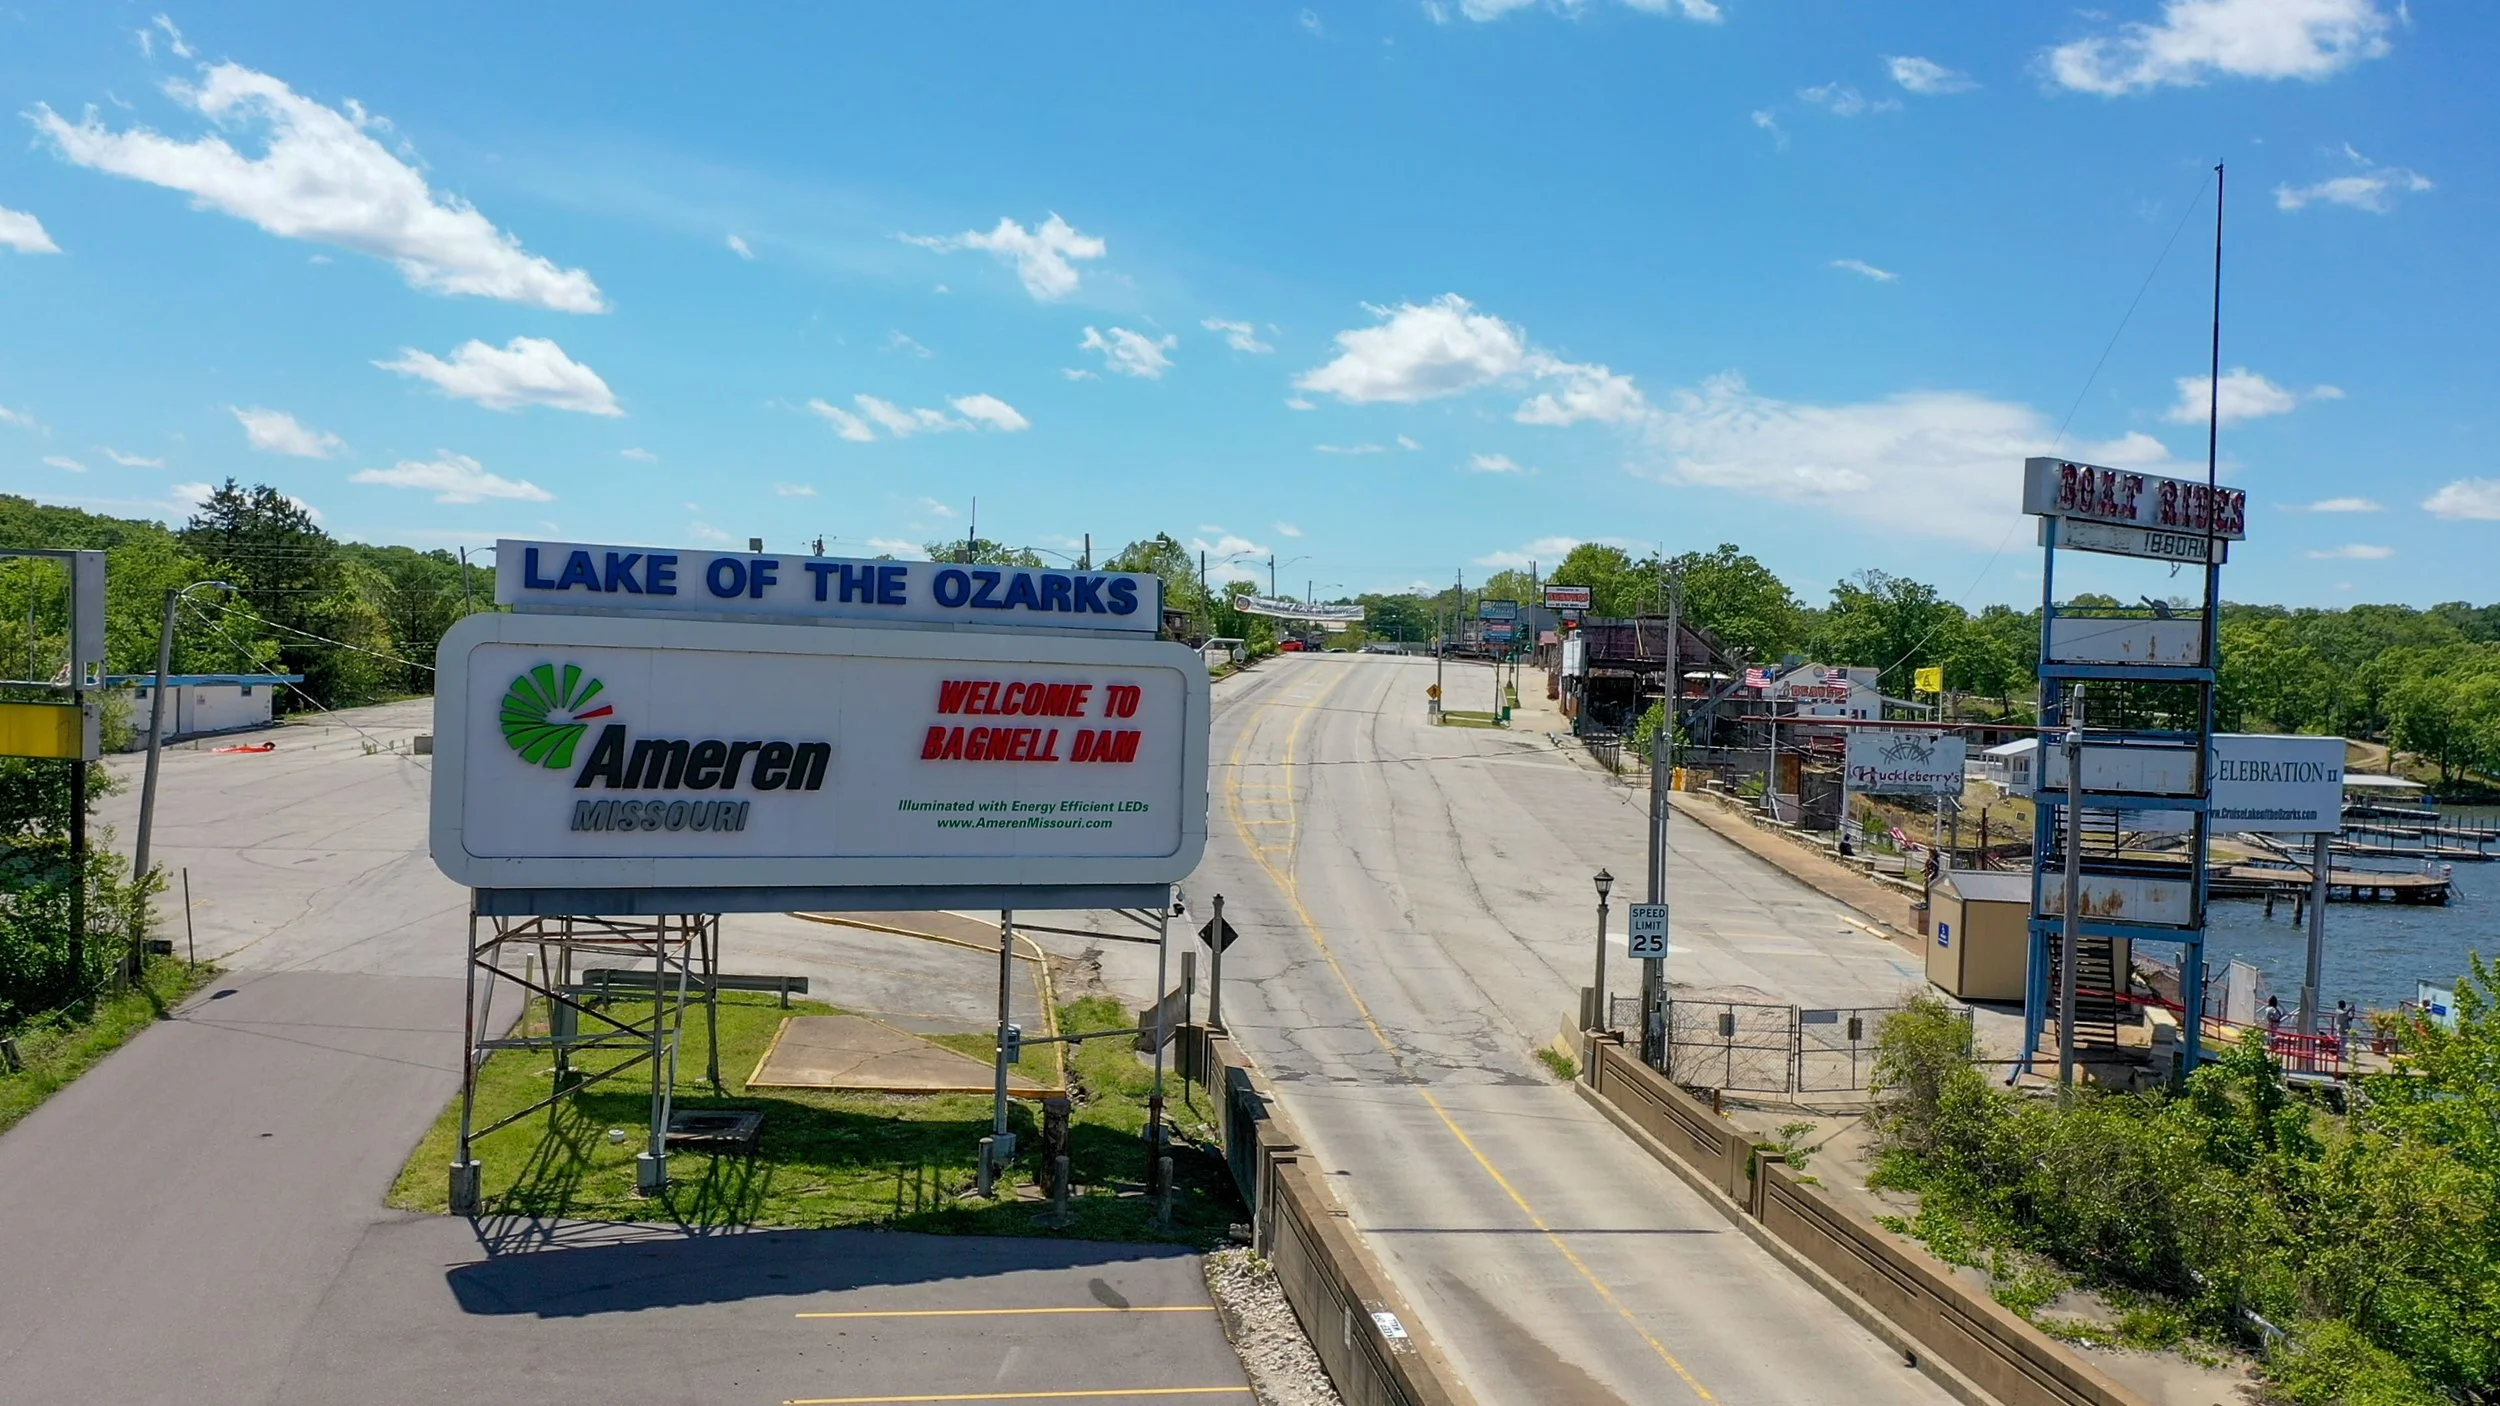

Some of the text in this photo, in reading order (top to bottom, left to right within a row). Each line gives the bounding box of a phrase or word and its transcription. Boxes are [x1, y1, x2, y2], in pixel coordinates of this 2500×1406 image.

[2059, 463, 2246, 535] BOAT RIDES
[524, 548, 1139, 616] LAKE OF THE OZARKS
[937, 680, 1141, 718] WELCOME TO
[573, 724, 832, 791] Ameren
[920, 726, 1142, 763] BAGNELL DAM
[1852, 765, 1960, 787] Huckleberry's
[570, 800, 750, 832] MISSOURI
[898, 800, 1149, 815] Illuminated with Energy Efficient LEDs
[937, 817, 1113, 829] www.AmerenMissouri.com
[1632, 908, 1666, 918] SPEED
[1635, 921, 1662, 930] LIMIT
[1632, 934, 1663, 952] 25
